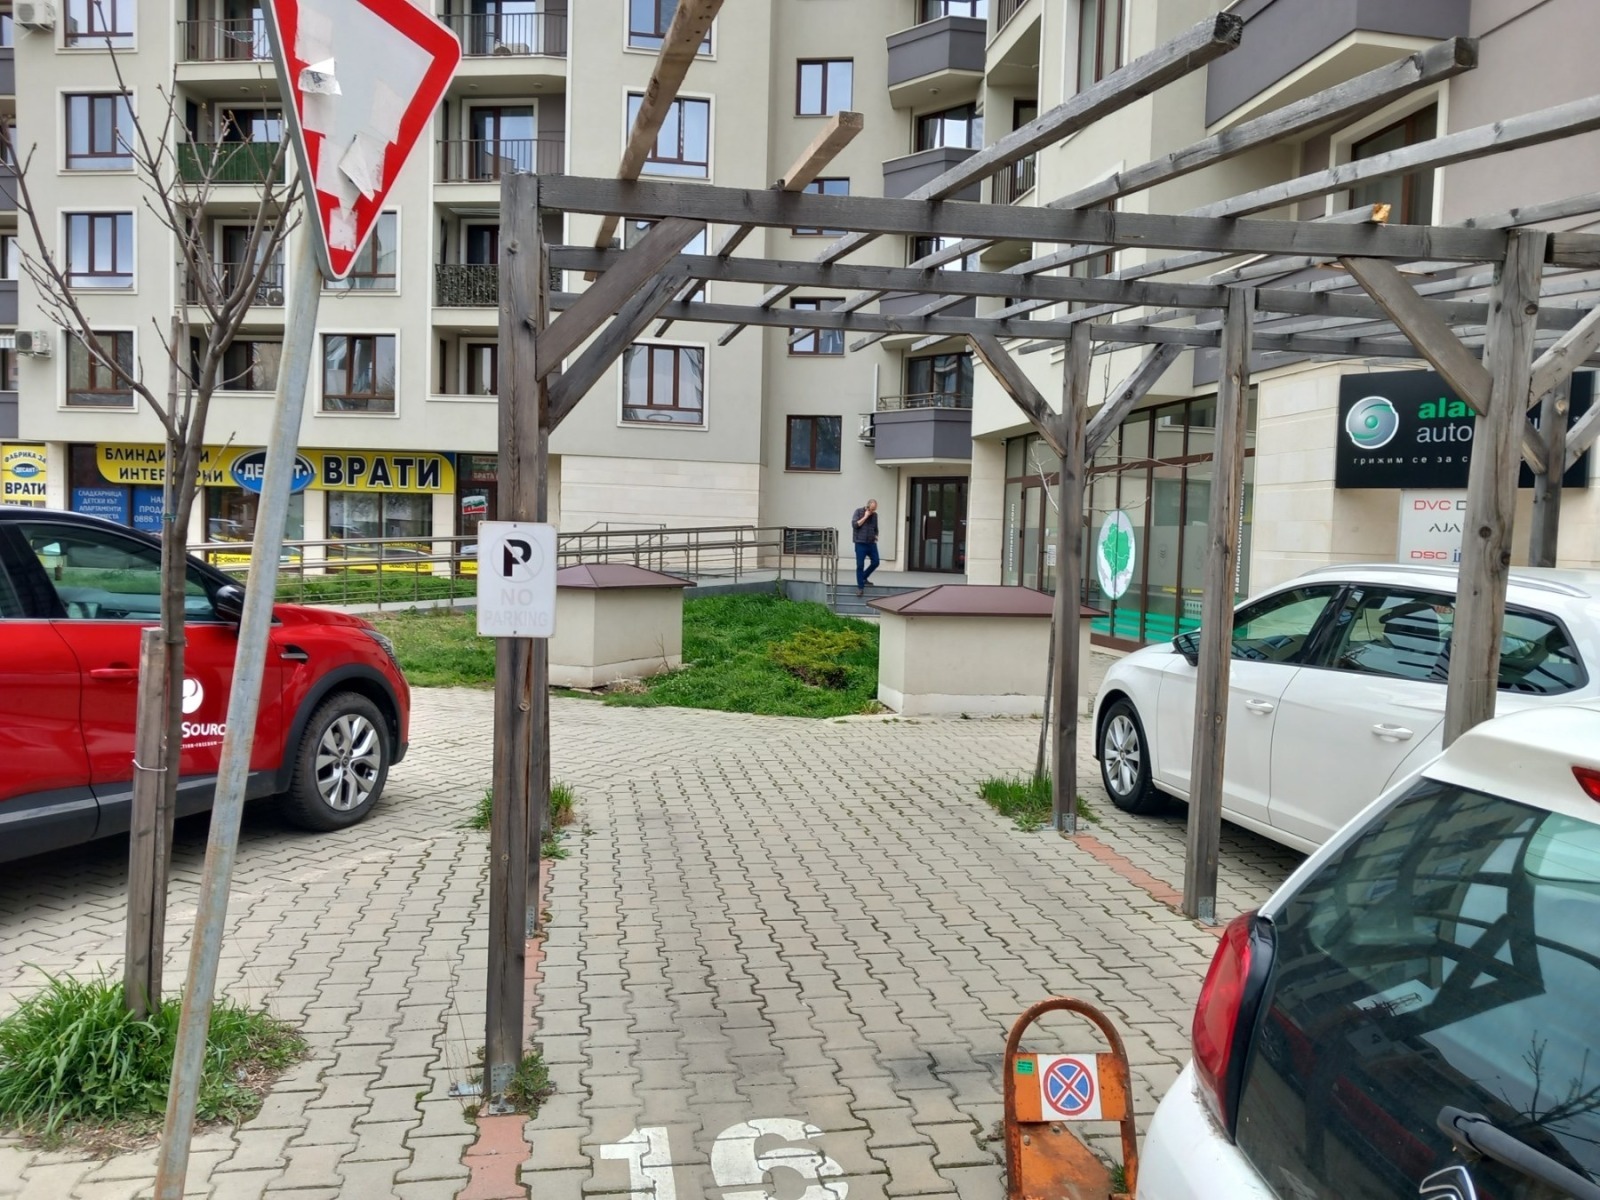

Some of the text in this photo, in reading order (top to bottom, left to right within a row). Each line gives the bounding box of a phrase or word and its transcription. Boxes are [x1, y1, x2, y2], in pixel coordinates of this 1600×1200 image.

[1416, 423, 1473, 443] auto
[4, 452, 36, 462] ФАБРИКА
[1353, 455, 1404, 464] грижим
[1412, 454, 1427, 463] се
[1437, 453, 1452, 463] за
[243, 463, 303, 481] ДЕТ
[322, 455, 441, 488] ВРАТИ
[4, 482, 46, 495] ВРАТИ
[1414, 500, 1451, 510] DVC
[1429, 523, 1461, 533] AJA
[1411, 551, 1447, 560] DSC
[501, 588, 533, 606] NO
[484, 609, 549, 628] PARKING
[600, 1117, 849, 1200] 16
